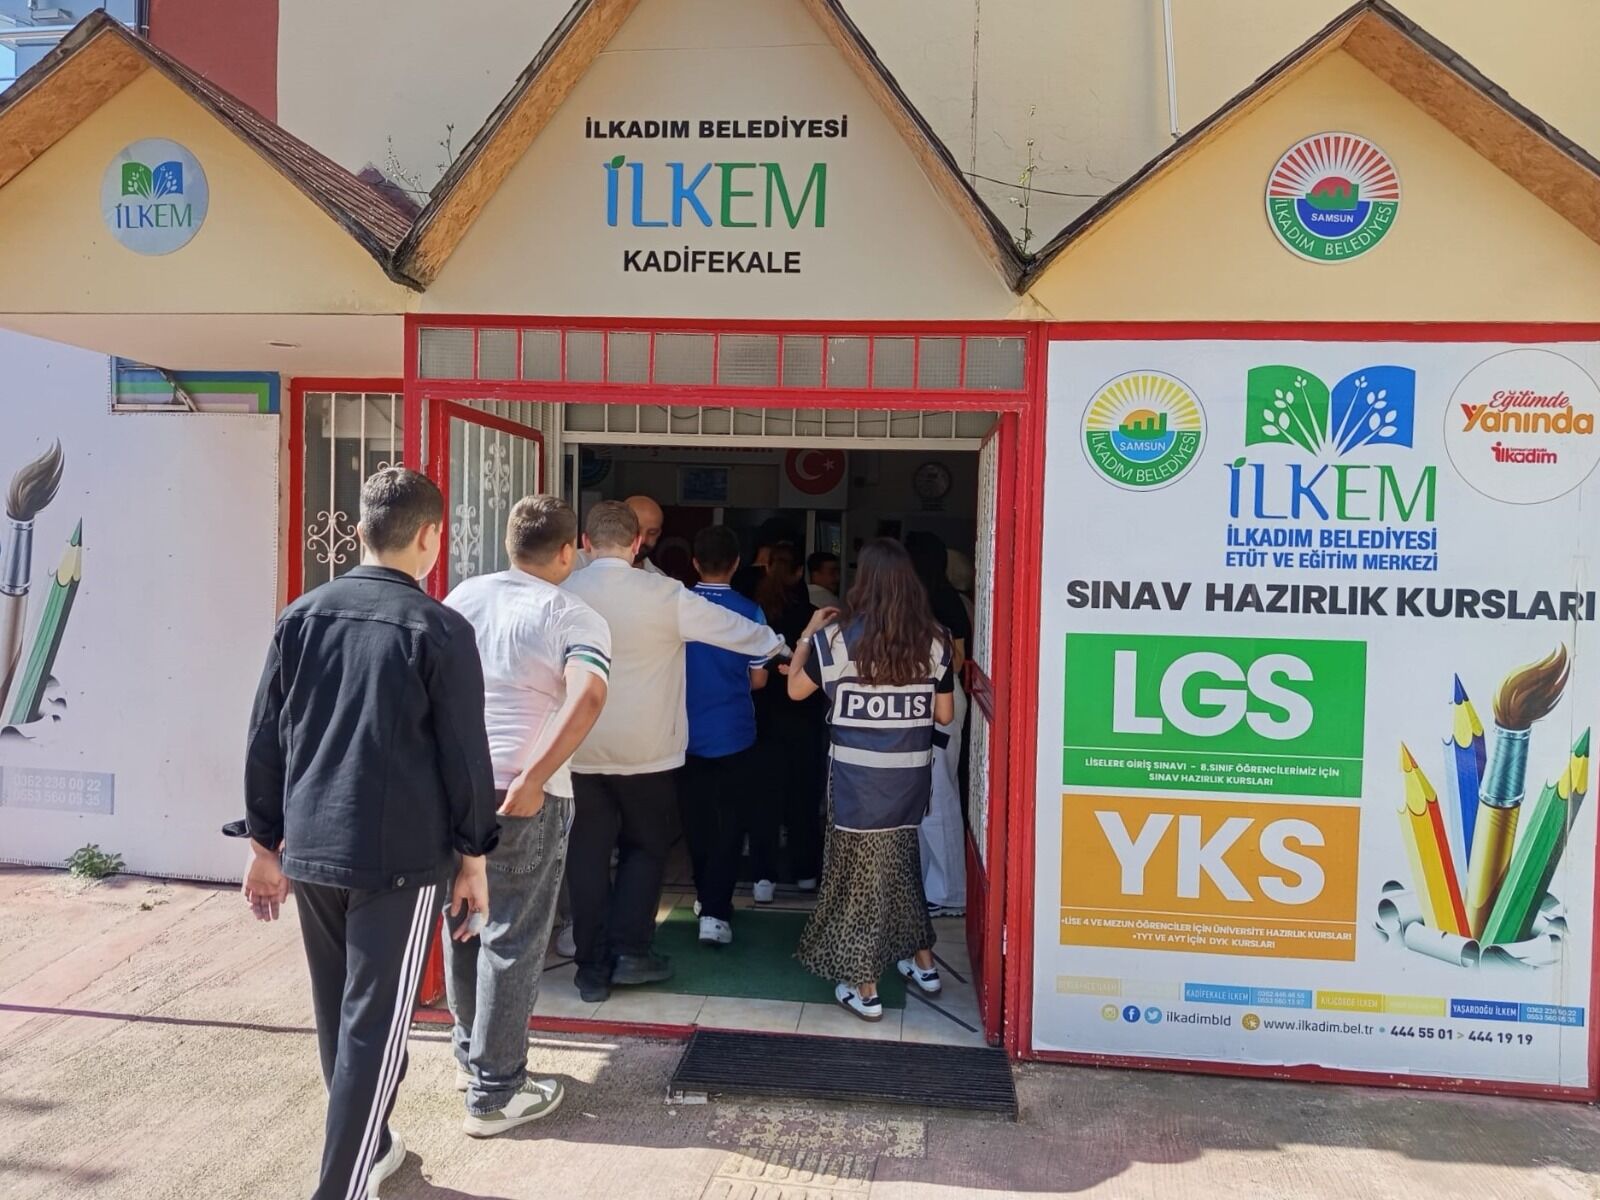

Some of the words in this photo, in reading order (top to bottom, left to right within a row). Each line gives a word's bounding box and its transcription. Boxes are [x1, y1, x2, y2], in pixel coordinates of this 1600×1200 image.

[585, 116, 690, 139] İLKADIM
[699, 115, 848, 139] BELEDİYESİ
[602, 155, 827, 229] İLKEM
[115, 203, 192, 229] İLKEM
[1275, 199, 1314, 252] İLKADIM
[1325, 201, 1395, 256] BELEDİYESİ
[1311, 213, 1354, 223] SAMSUN
[623, 245, 801, 274] KADİFEKALE
[1489, 390, 1570, 412] Eğitimde
[1460, 403, 1594, 435] Yanında
[1092, 432, 1133, 480] İLKADIM
[1136, 432, 1197, 482] BELEDİYESİ
[1120, 442, 1166, 452] SAMSUN
[1224, 456, 1438, 522] İLKEM
[1227, 524, 1313, 548] İLKADIM
[1319, 526, 1437, 550] BELEDİYESİ
[1225, 548, 1268, 568] ETÜT
[1273, 552, 1294, 568] VE
[1299, 550, 1358, 569] EĞİTİM
[1363, 552, 1438, 571] MERKEZİ
[1066, 579, 1192, 610] SINAV
[1205, 581, 1396, 617] HAZIRLIK
[1397, 585, 1596, 622] KURSLARI
[1113, 650, 1314, 740] LGS
[1085, 757, 1125, 768] LİSELERE
[1126, 759, 1152, 771] GİRİŞ
[1153, 761, 1187, 770] SINAVI
[1200, 763, 1234, 772] 8.SINIF
[1236, 763, 1316, 776] ÖĞRENCİLERİMİZ
[1318, 766, 1340, 778] İÇİN
[1149, 773, 1179, 782] SINAV
[1180, 774, 1224, 784] HAZIRLIK
[1226, 776, 1274, 786] KURSLARI
[1094, 810, 1325, 905] YKS
[1091, 918, 1103, 926] VE
[1103, 919, 1136, 928] MEZUN
[1266, 928, 1307, 938] HAZIRLIK
[1307, 930, 1352, 941] KURSLARI
[1154, 933, 1167, 941] VE
[1167, 934, 1186, 943] AYT
[1231, 938, 1276, 949] KURSLARI
[1495, 1005, 1516, 1016] İLKEM
[1263, 1019, 1374, 1036] www.ilkadim.bel.tr
[1390, 1025, 1415, 1038] 444
[1418, 1026, 1435, 1039] 55
[1438, 1028, 1453, 1040] 01
[1468, 1030, 1493, 1042] 444
[1497, 1032, 1513, 1044] 19
[1517, 1033, 1533, 1045] 19
